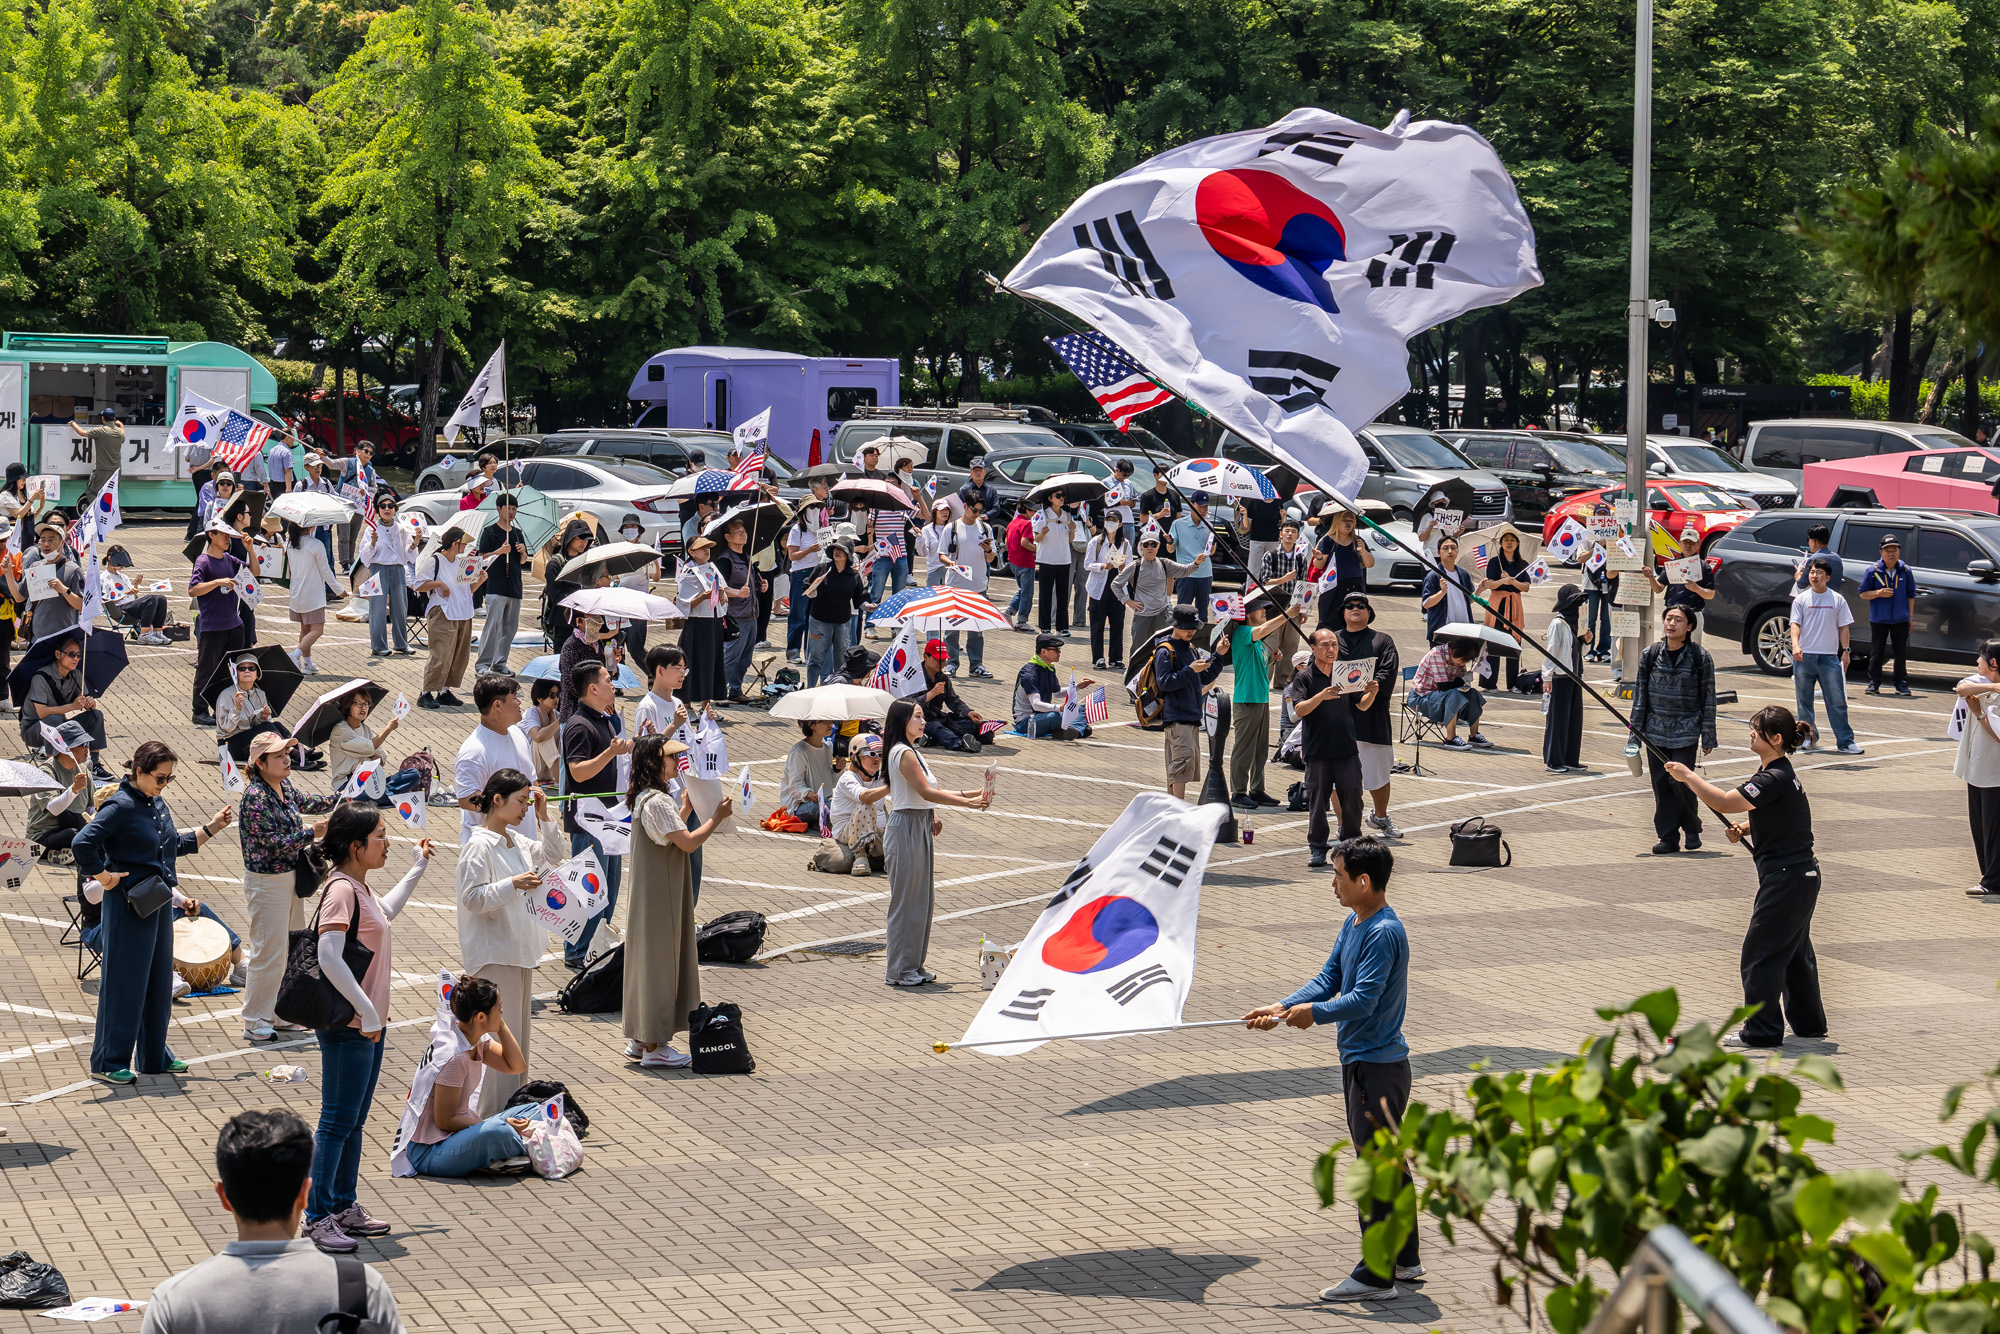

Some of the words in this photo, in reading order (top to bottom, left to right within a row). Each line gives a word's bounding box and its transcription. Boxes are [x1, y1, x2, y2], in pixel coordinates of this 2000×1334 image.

[71, 438, 149, 463] 재거
[30, 480, 56, 491] 재거
[1434, 512, 1460, 526] 재선거
[1594, 528, 1618, 537] 재선거
[699, 1043, 736, 1053] KANGOL
